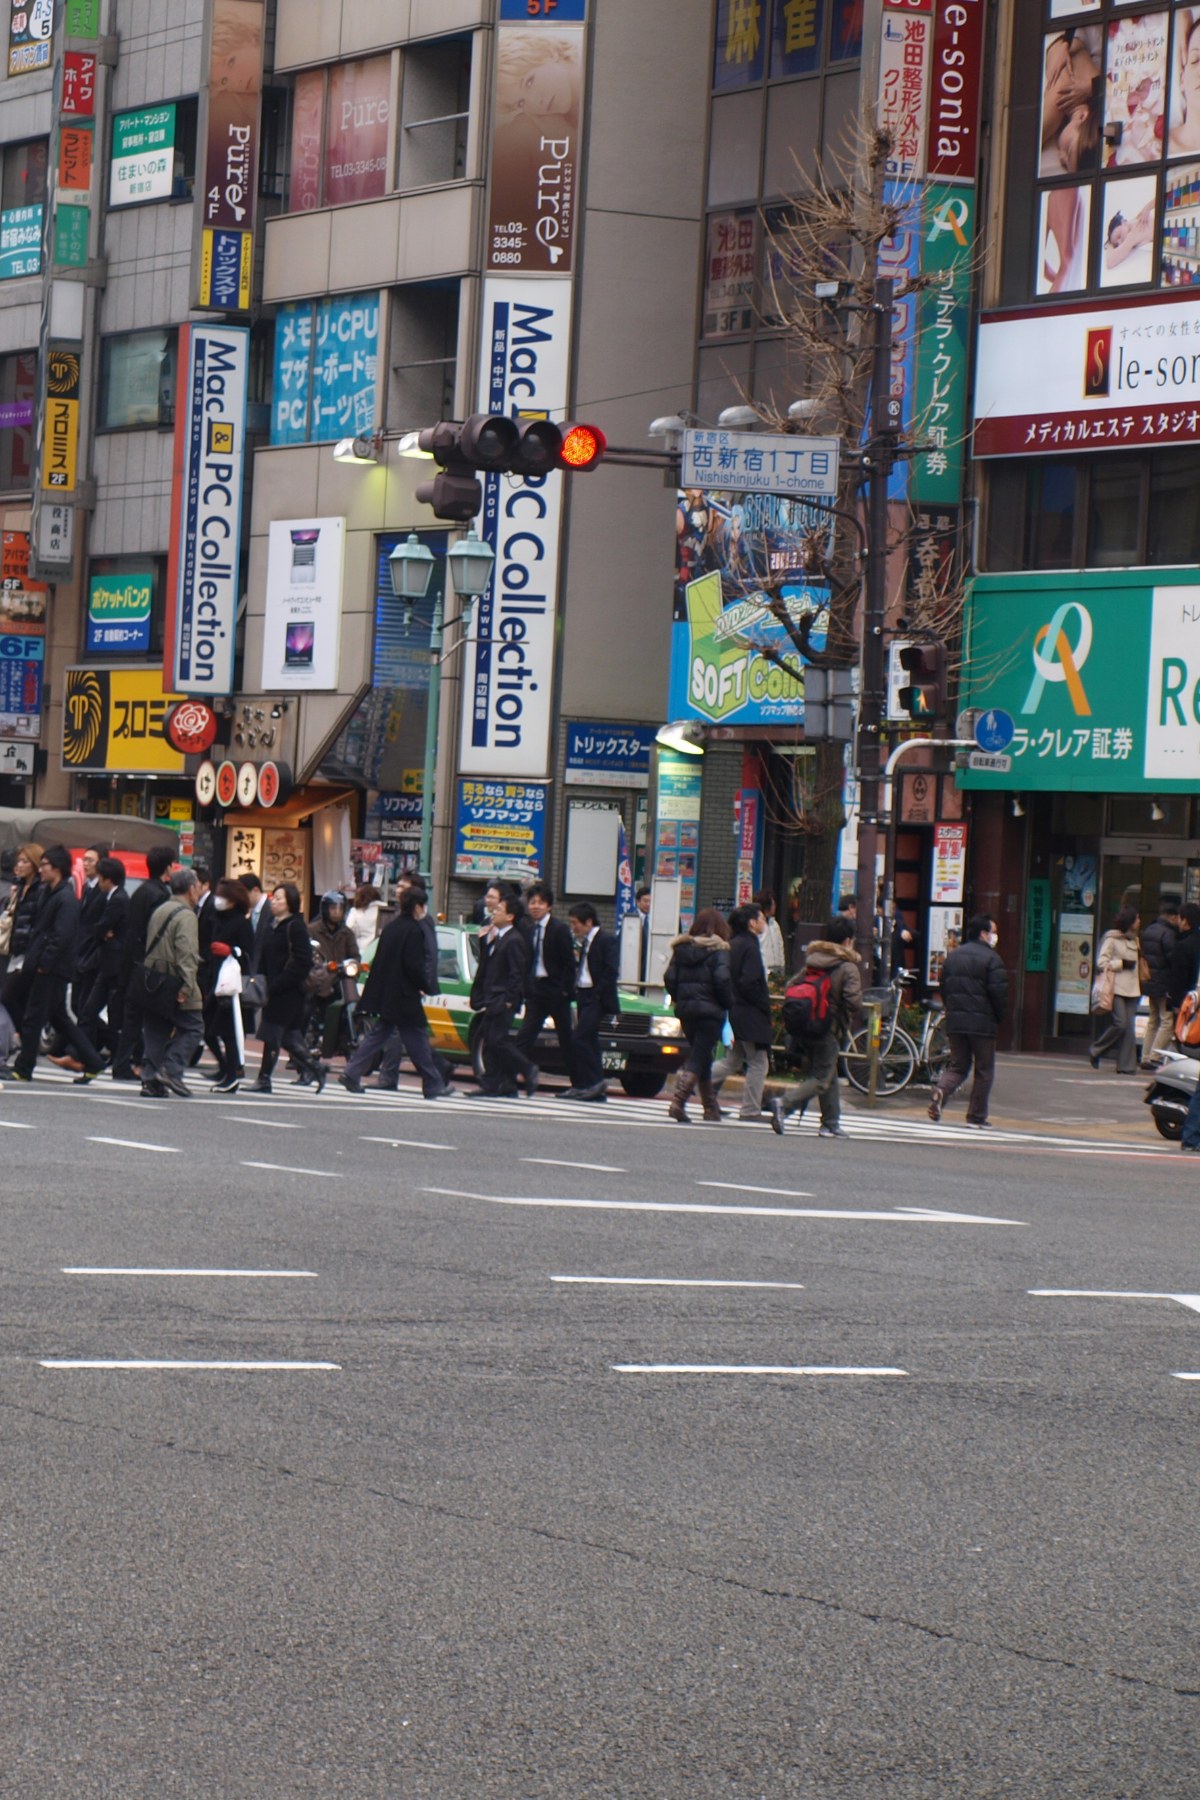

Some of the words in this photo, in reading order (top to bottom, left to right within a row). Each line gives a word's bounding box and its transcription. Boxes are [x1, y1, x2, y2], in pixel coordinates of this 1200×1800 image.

[527, 0, 558, 14] 5F
[41, 19, 51, 36] 5
[63, 69, 77, 110] ホーム
[80, 58, 94, 100] アイワ
[900, 19, 926, 161] 池田整形外科
[937, 0, 979, 158] e-sonia
[117, 158, 167, 182] 住まいの森
[225, 123, 251, 211] Pure
[885, 160, 914, 174] 3F
[535, 135, 570, 242] Pure
[0, 225, 42, 249] 新宿みなみ
[493, 236, 527, 249] 3345-
[11, 261, 26, 275] TEL
[492, 250, 521, 264] 0880
[282, 307, 379, 351] メモリ・CPU
[508, 303, 554, 398] Mac
[205, 340, 238, 414] Mac
[1024, 415, 1135, 445] メディカルエステ
[1141, 410, 1200, 435] スタジオ
[52, 402, 70, 469] プロミス
[693, 431, 731, 445] 新宿区
[692, 446, 830, 475] 西新宿1丁目
[50, 474, 67, 485] 2F
[203, 463, 233, 507] PC
[695, 469, 770, 488] Nishishinjuku
[776, 474, 826, 490] 1-chome
[3, 579, 21, 591] 5F
[92, 587, 150, 609] ポケットバンク
[195, 516, 234, 682] Collection
[0, 636, 40, 658] 6F
[494, 531, 548, 749] Collection
[691, 656, 748, 709] SOFT
[574, 734, 651, 757] トリックスター
[1010, 727, 1134, 761] ラ・クレア証券
[463, 782, 504, 796] 売るなら
[383, 796, 425, 813] ソフマップ
[463, 795, 544, 812] ワクワクするなら
[471, 807, 533, 823] ソフマップ
